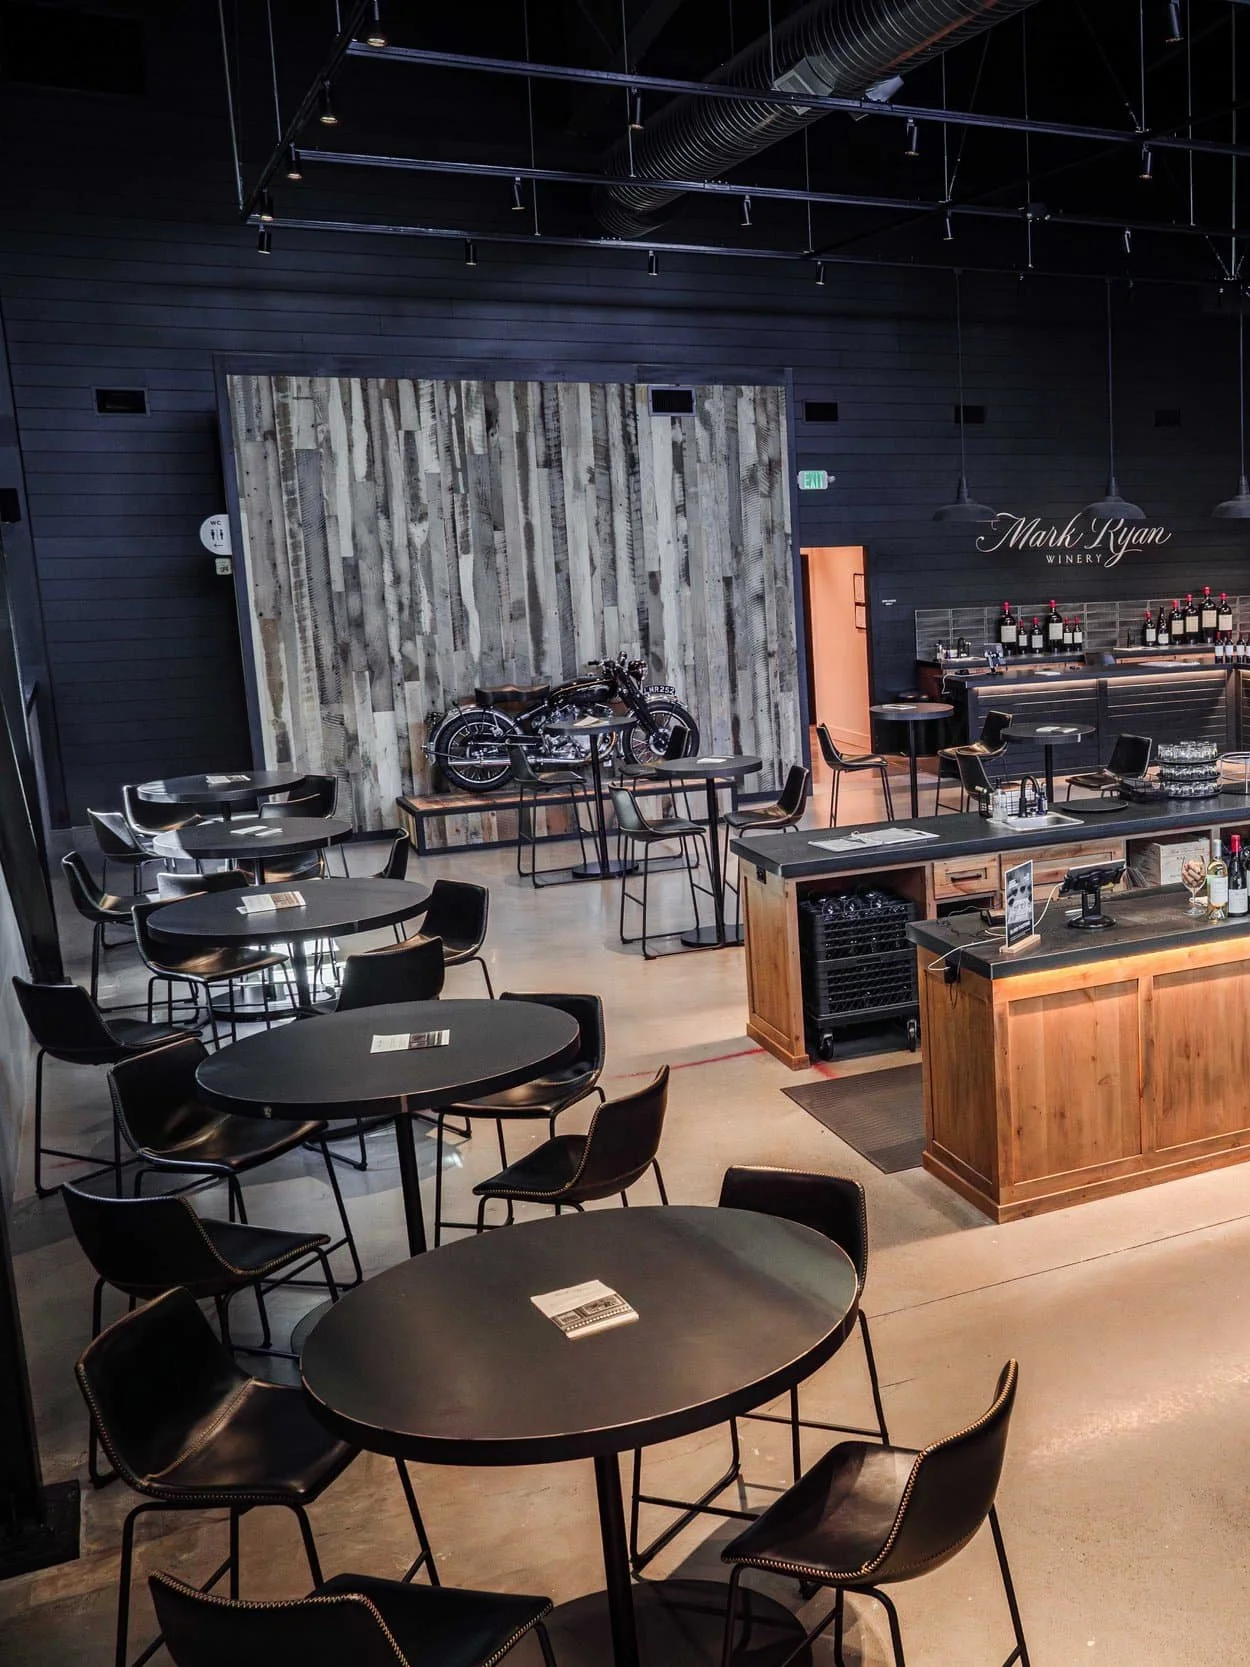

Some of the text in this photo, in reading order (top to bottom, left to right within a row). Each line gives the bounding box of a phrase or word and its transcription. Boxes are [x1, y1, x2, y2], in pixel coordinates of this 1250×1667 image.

[803, 471, 824, 488] EXIT
[976, 512, 1172, 568] Mark Ryan
[1046, 554, 1102, 564] WINERY
